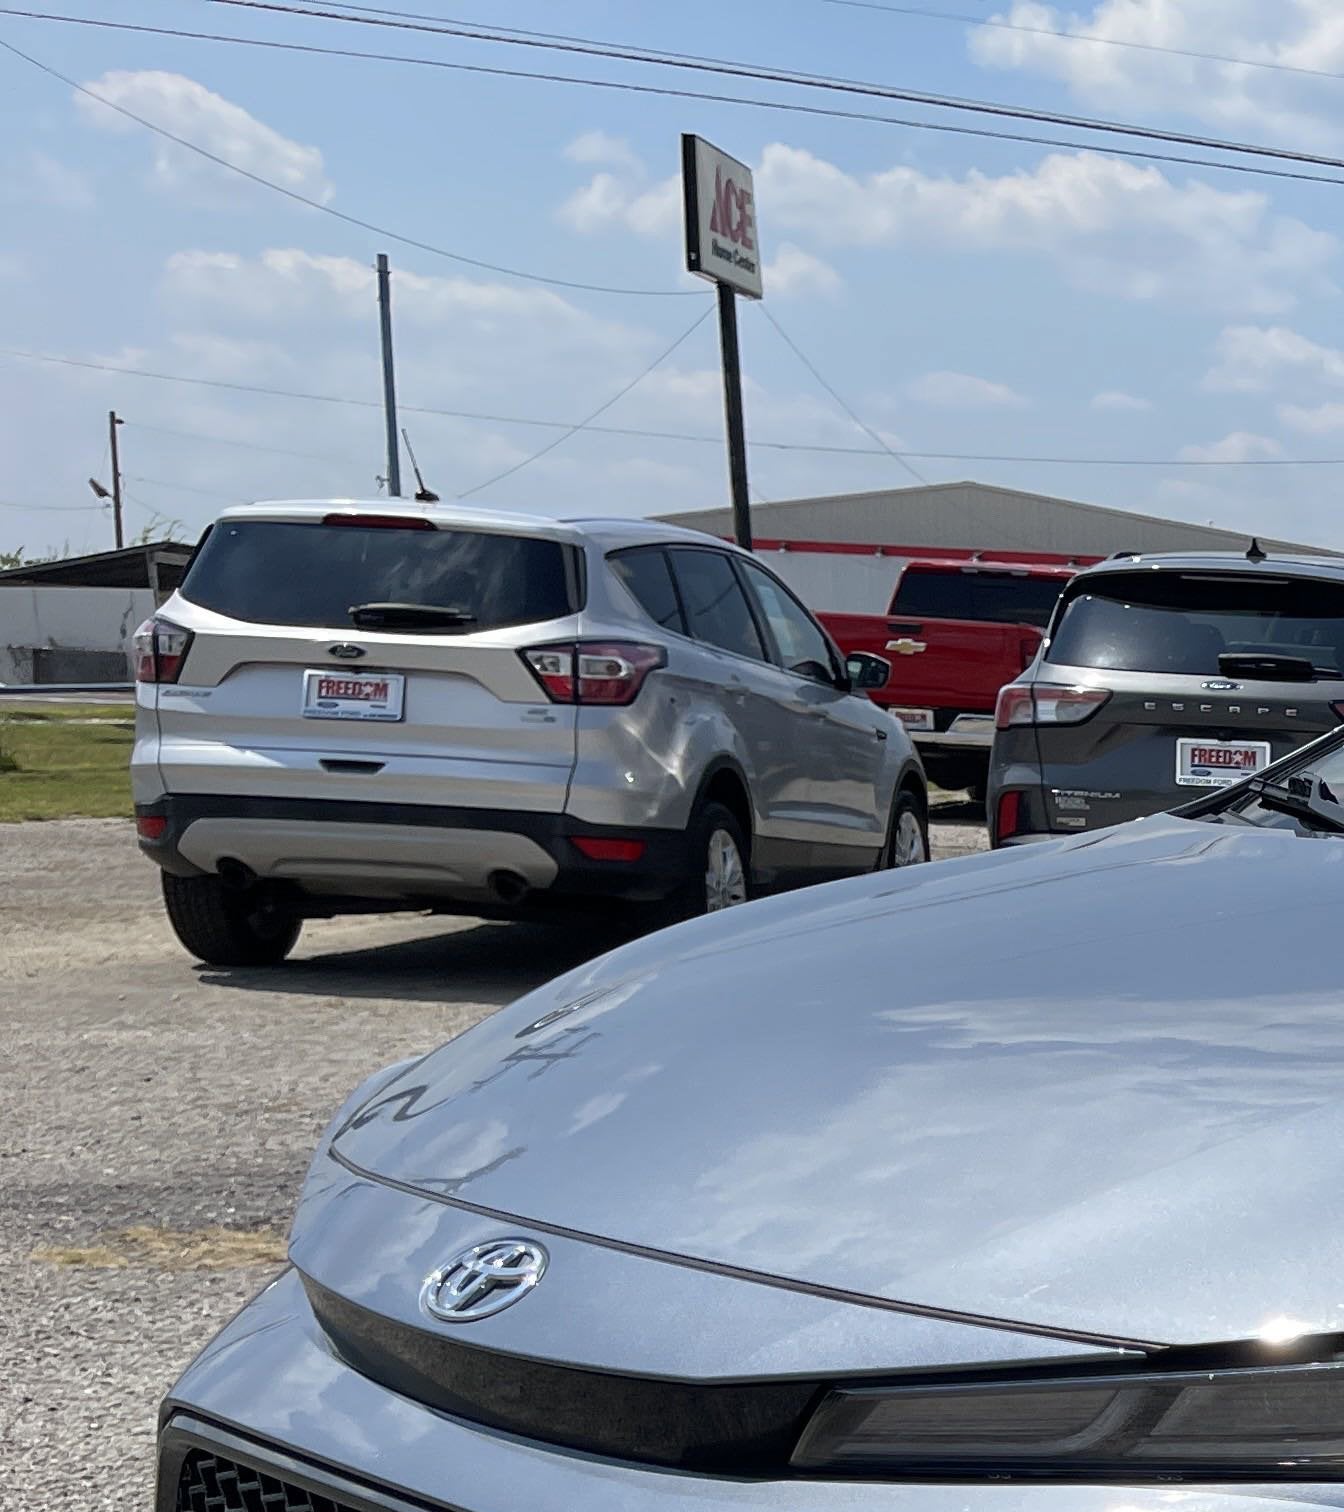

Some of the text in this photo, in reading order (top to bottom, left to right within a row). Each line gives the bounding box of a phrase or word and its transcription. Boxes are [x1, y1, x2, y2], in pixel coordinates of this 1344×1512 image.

[710, 163, 754, 251] ACE
[319, 679, 389, 698] FREEDOM
[1144, 702, 1298, 717] ESCAPE
[1191, 747, 1257, 767] FREEDOM
